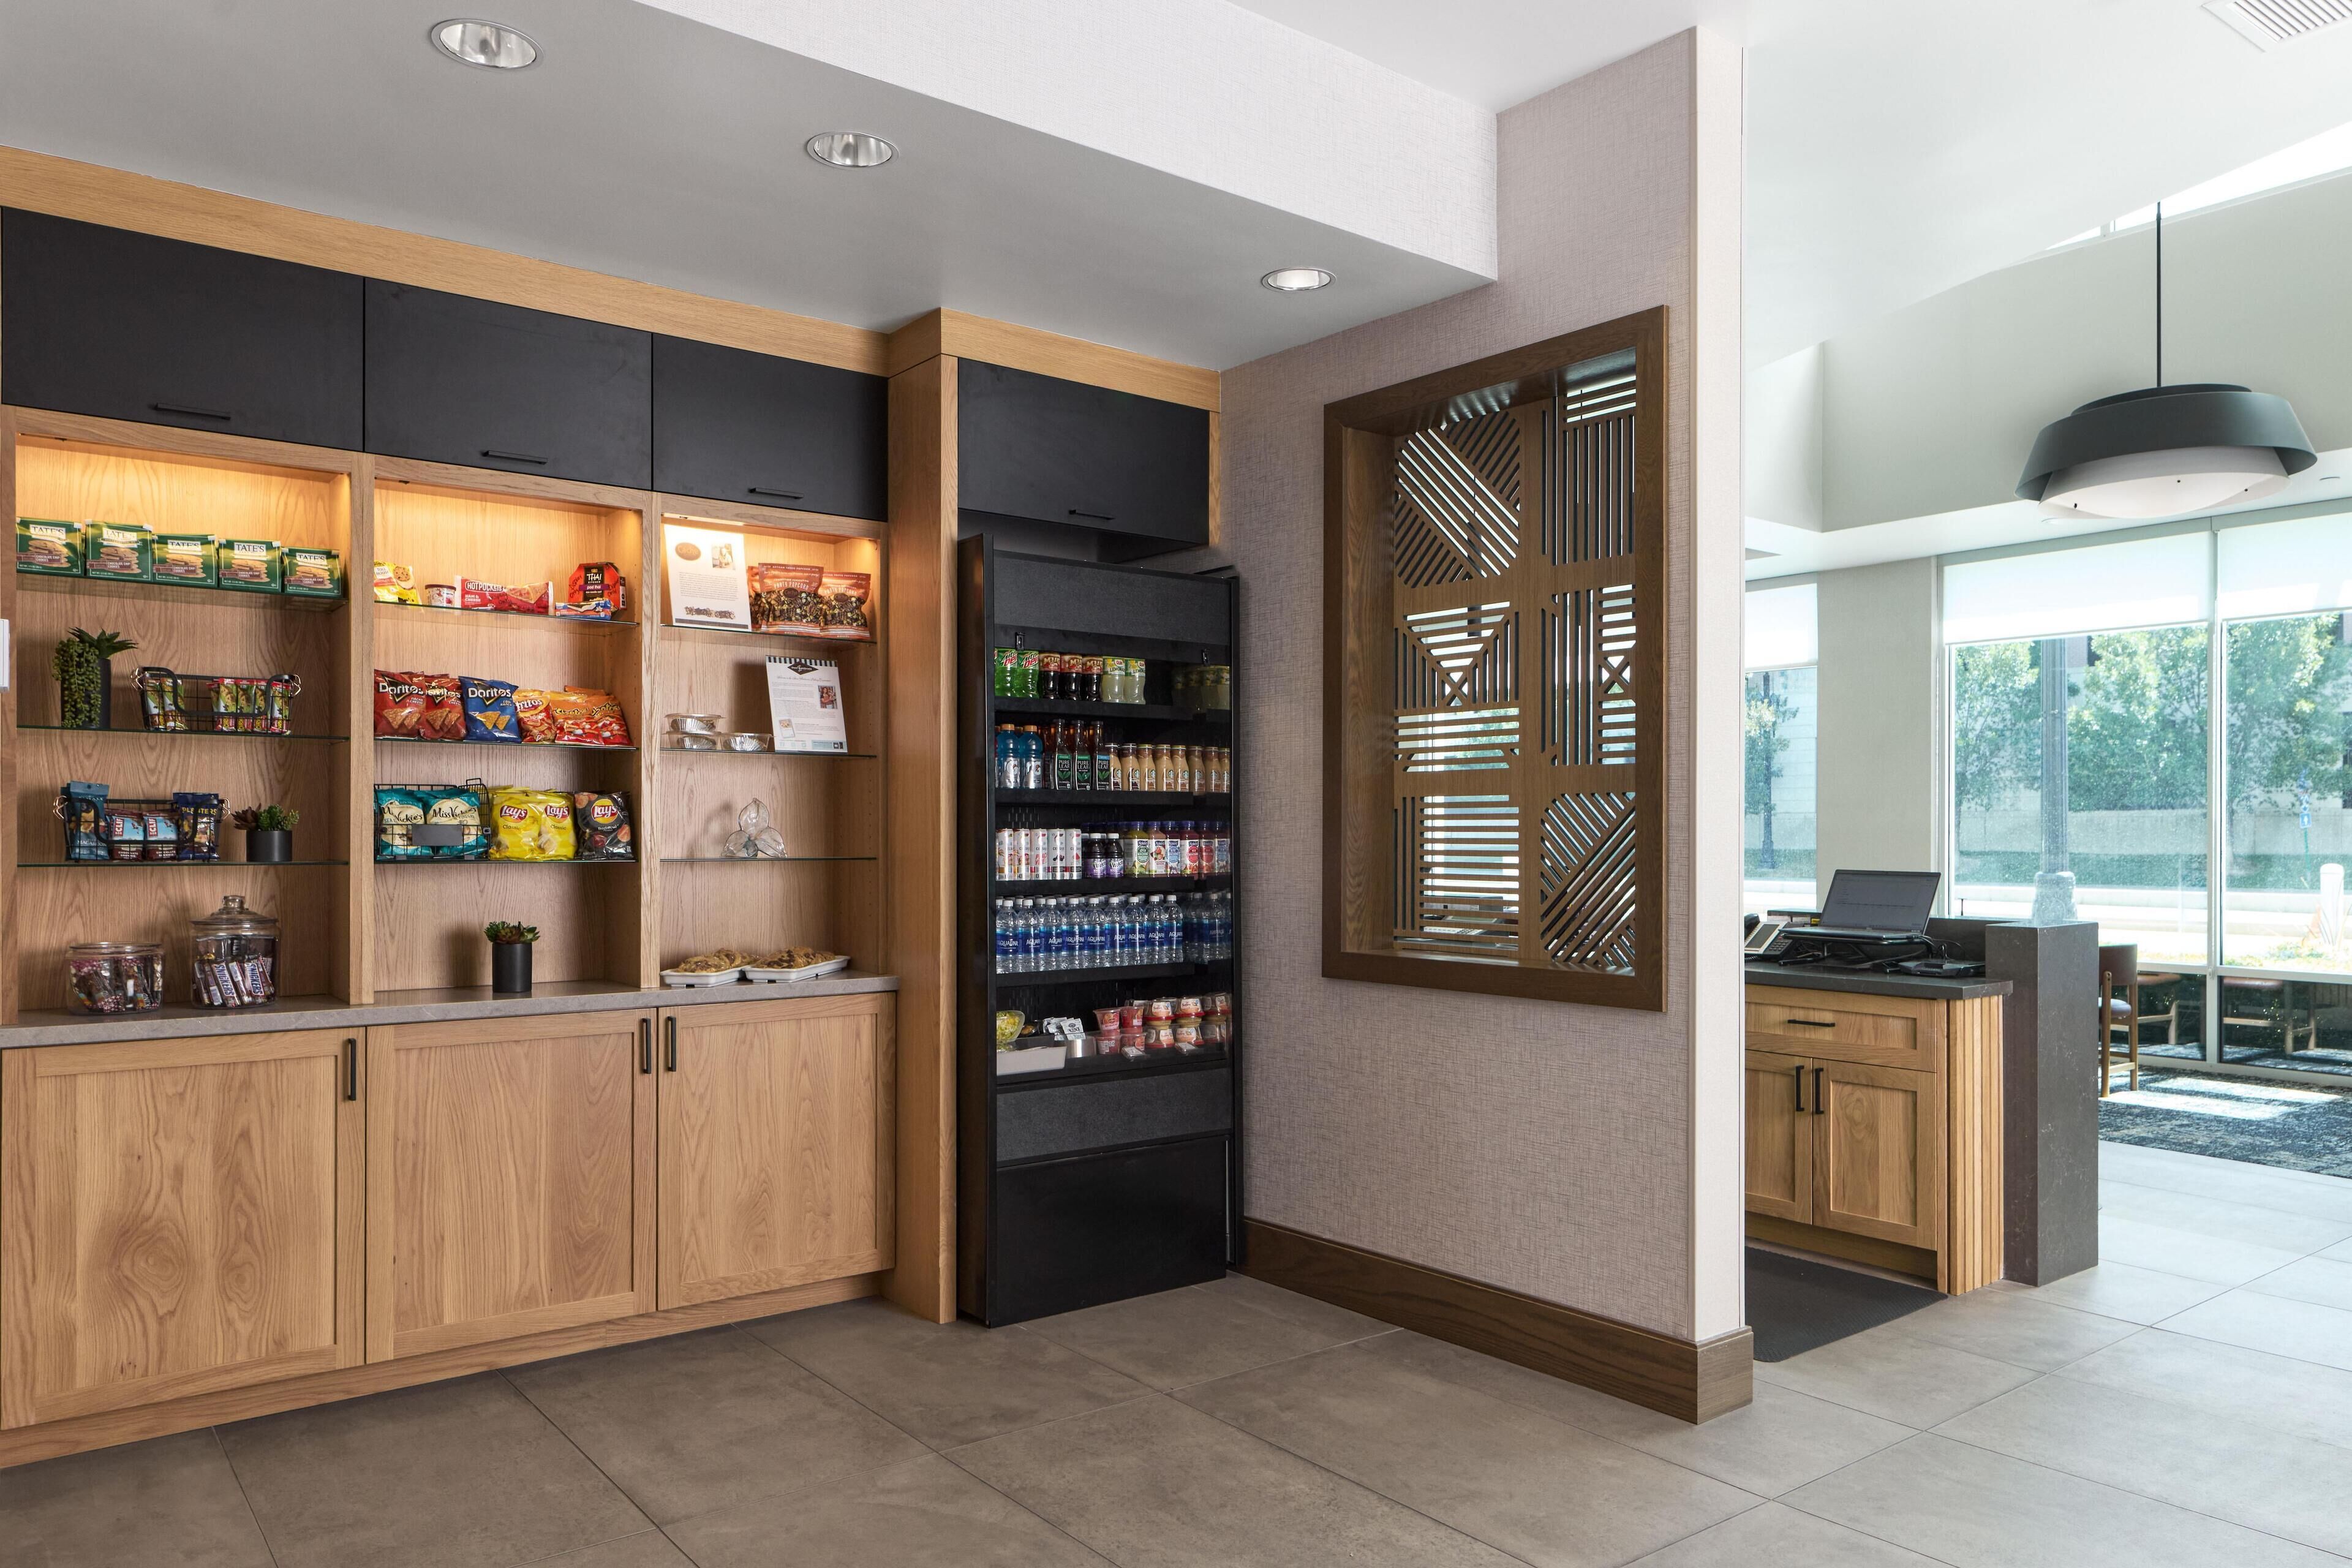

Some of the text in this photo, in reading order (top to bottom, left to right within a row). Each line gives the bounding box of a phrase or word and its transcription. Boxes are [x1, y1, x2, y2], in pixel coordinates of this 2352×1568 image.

[32, 526, 64, 535] TATE'S
[479, 583, 502, 592] POCKETS
[789, 581, 809, 590] POPCORN
[379, 682, 424, 695] Doritos
[468, 687, 511, 698] Doritos
[432, 808, 451, 818] Miss
[501, 805, 527, 820] Lay's
[546, 805, 569, 818] Lay's
[593, 804, 617, 818] Lay's
[115, 818, 123, 832] CLIF
[215, 964, 235, 995] SNICKERS
[248, 963, 264, 995] SNICKERS
[142, 993, 151, 1008] KIND
